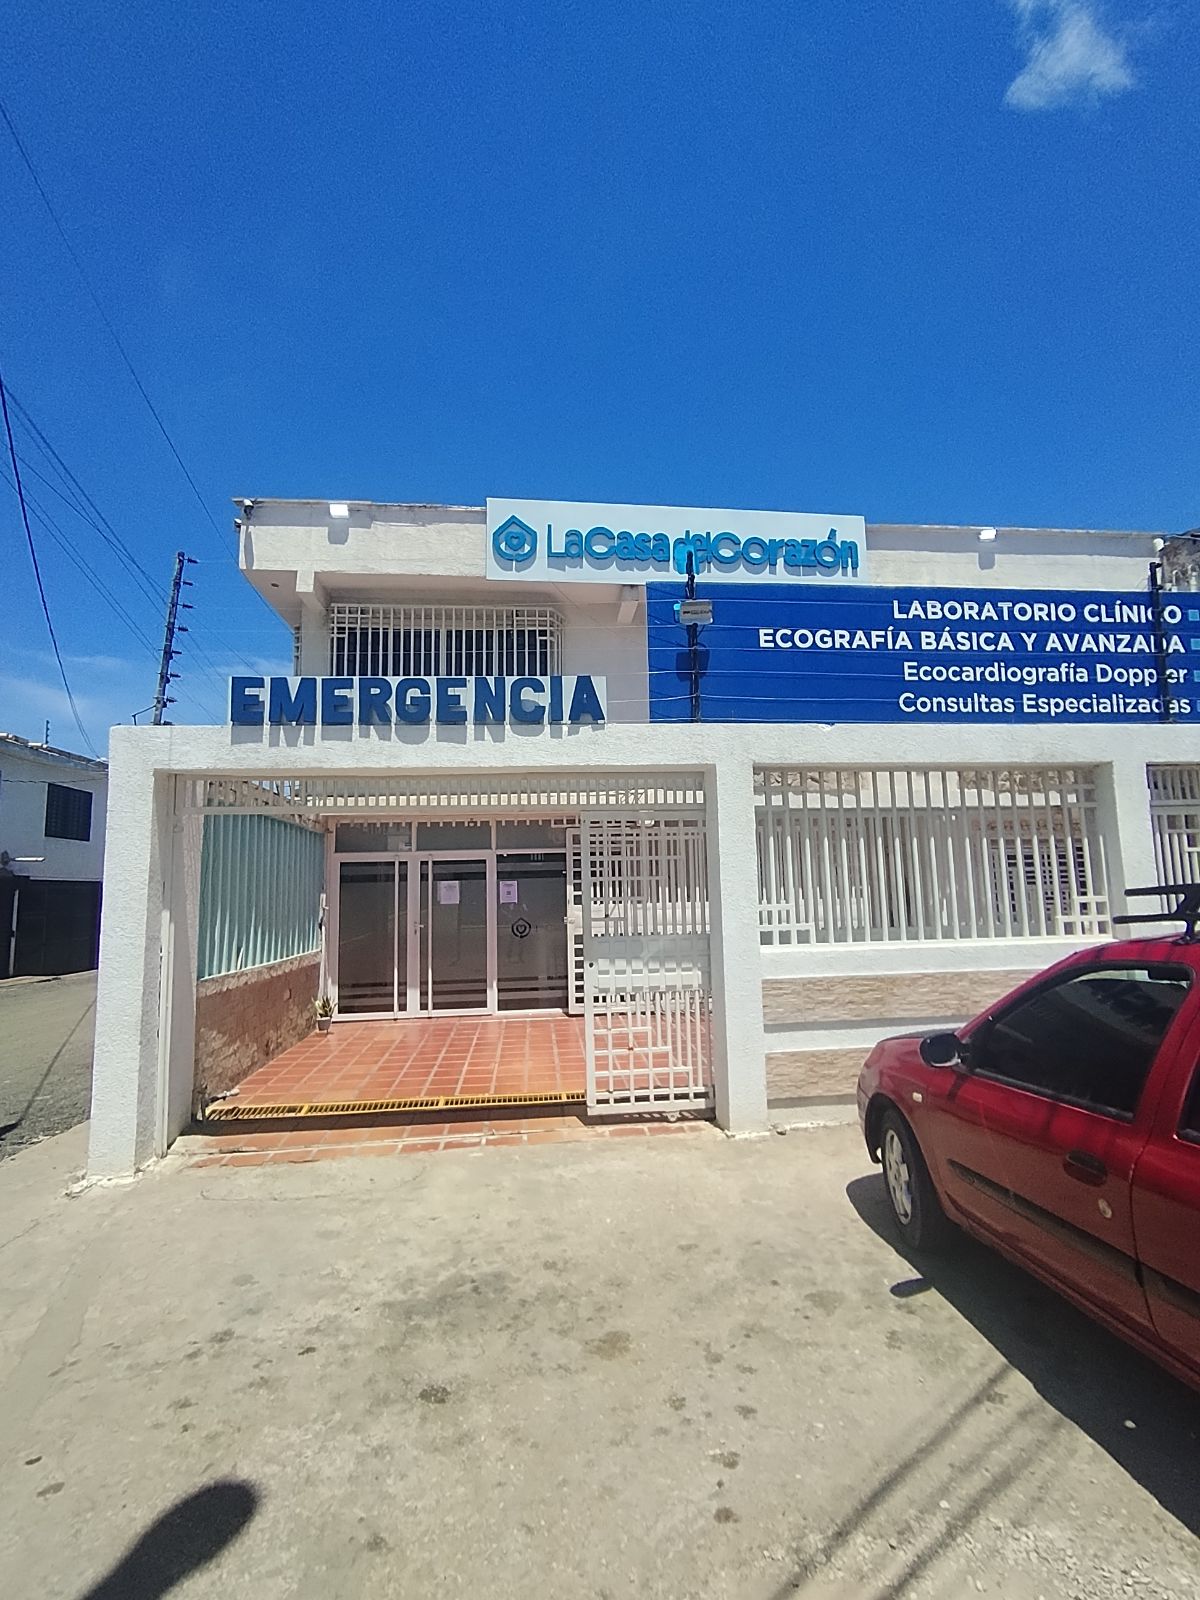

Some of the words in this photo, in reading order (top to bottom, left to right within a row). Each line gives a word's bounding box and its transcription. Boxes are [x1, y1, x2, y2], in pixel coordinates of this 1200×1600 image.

[893, 600, 1077, 622] LABORATORIO
[758, 626, 913, 650] ECOGRAFÍA
[920, 626, 1015, 651] BÁSICA
[1020, 632, 1037, 651] Y
[903, 661, 1089, 686] Ecocardiografía
[1096, 663, 1188, 687] Dopper
[230, 675, 606, 723] EMERGENCIA
[899, 692, 1015, 713] Consultas
